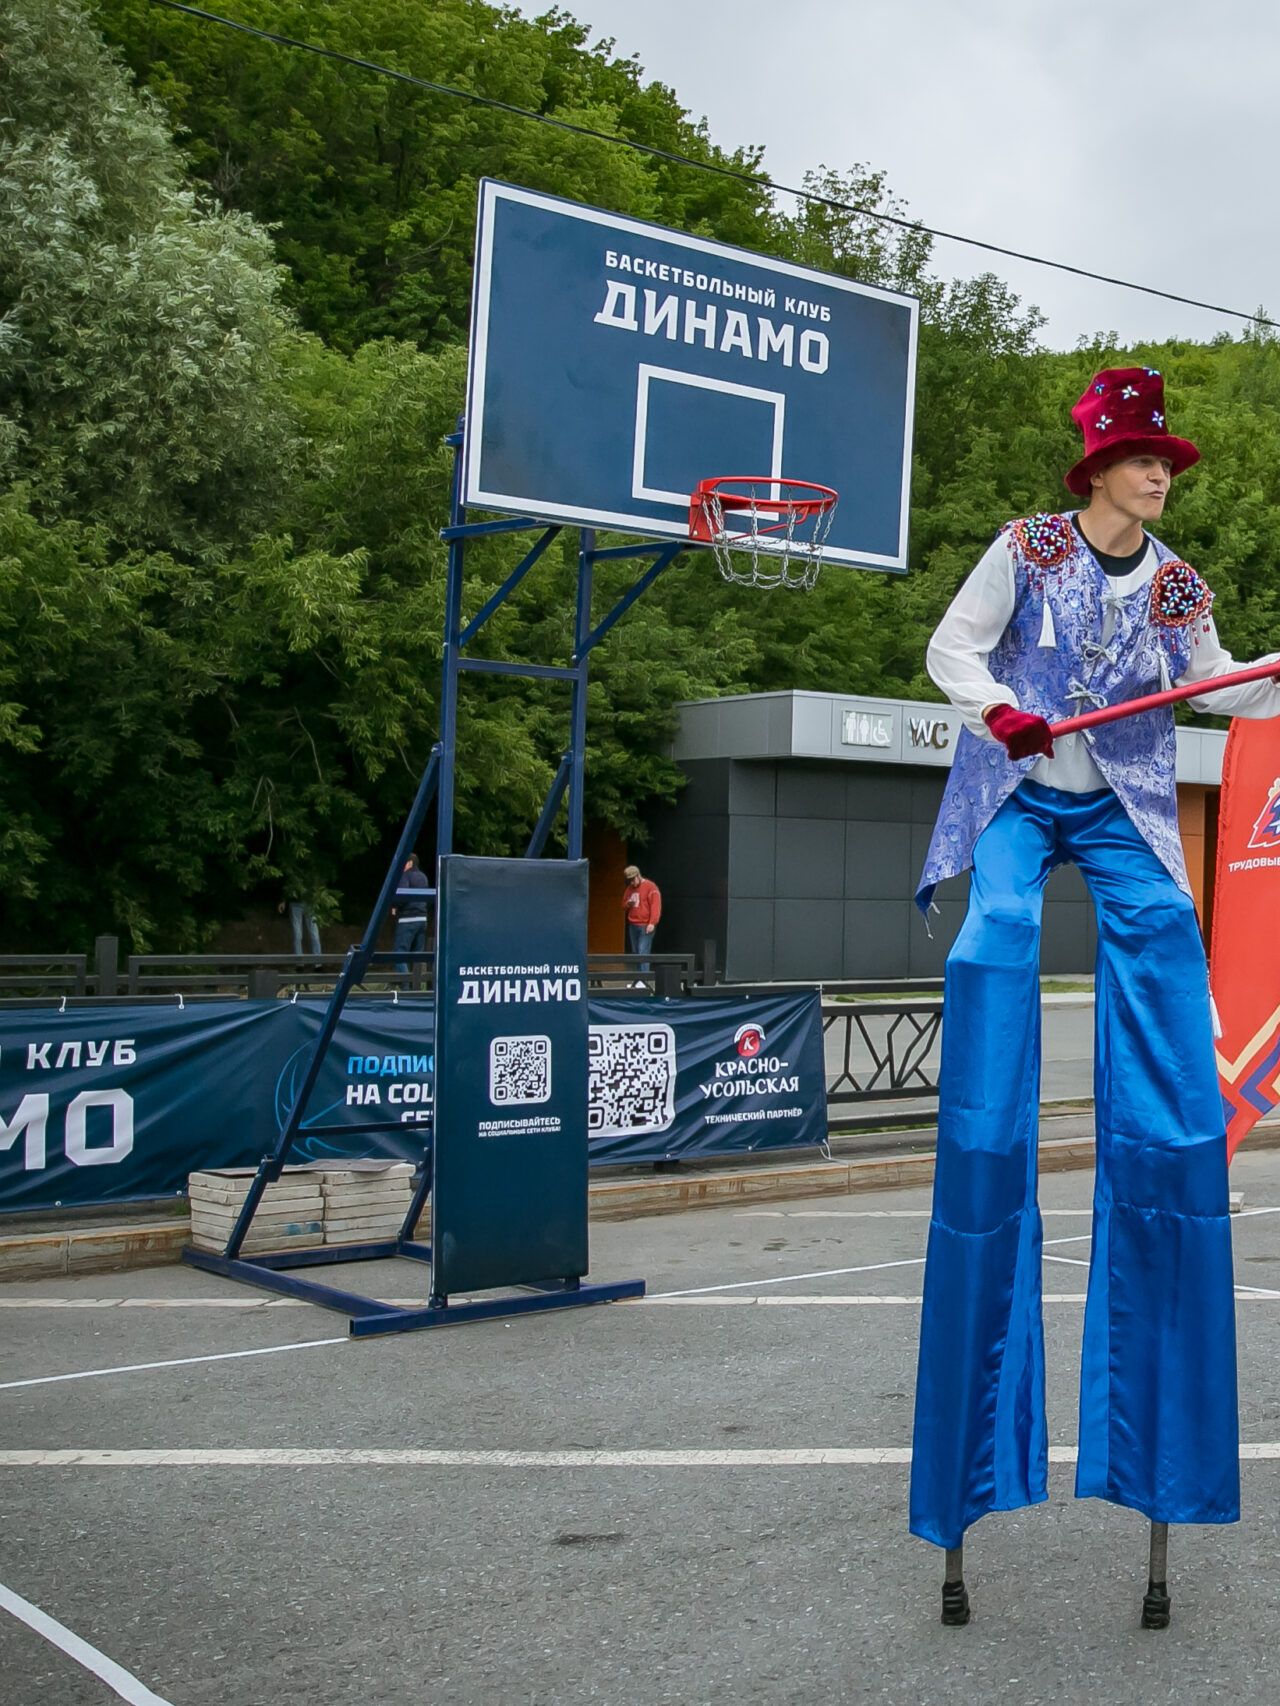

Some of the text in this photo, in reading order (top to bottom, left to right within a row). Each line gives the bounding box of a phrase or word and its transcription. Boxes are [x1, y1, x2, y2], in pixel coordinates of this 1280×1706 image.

[605, 250, 832, 322] БАСКЕТБОЛЬНЫЙ КЛУБ
[594, 279, 830, 375] ДИНАМО
[909, 717, 949, 749] WC
[459, 964, 579, 975] БАСКЕТБОЛЬНЫЙ КЛУБ
[457, 979, 581, 1004] ДИНАМО
[26, 1039, 137, 1069] КЛУБ
[715, 1057, 788, 1078] КРАСНО-
[346, 1083, 381, 1105] НА
[699, 1076, 799, 1099] УСОЛЬСКАЯ
[478, 1115, 561, 1130] ПОДПИСЫВАЙТЕСЬ
[705, 1107, 803, 1124] ТЕХНИЧЕСКИЙ ПАРТНЁР
